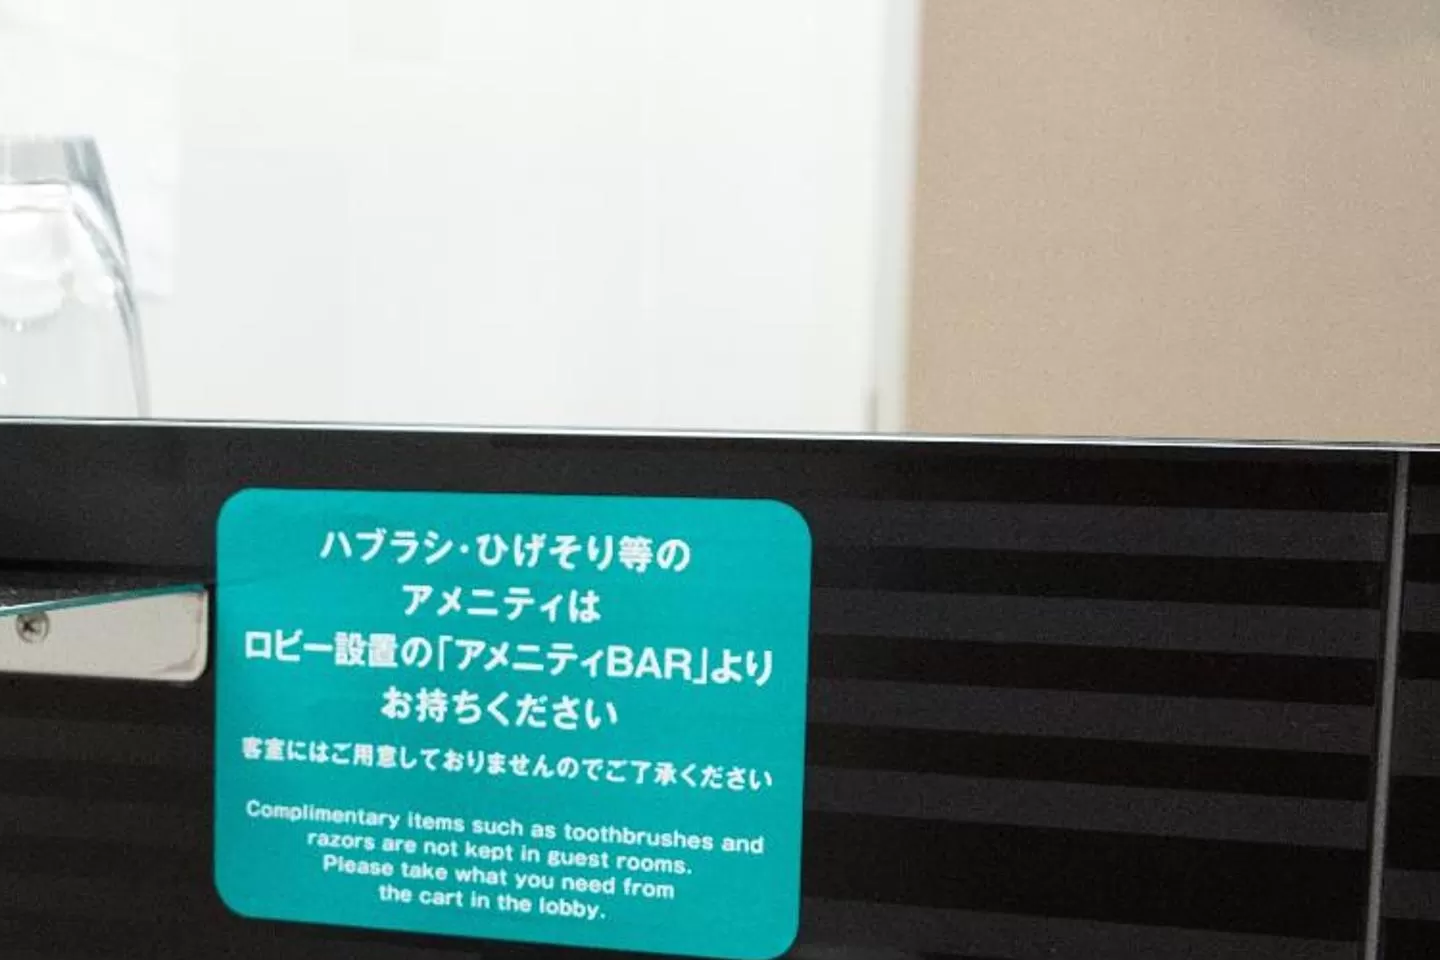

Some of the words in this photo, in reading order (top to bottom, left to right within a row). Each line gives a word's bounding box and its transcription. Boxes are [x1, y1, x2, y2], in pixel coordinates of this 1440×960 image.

[402, 585, 601, 622] アメニティは
[245, 630, 773, 686] ロビー設置の「アメニティBAR」より
[381, 686, 617, 731] お持ちください
[246, 801, 400, 830] Complimentary
[407, 812, 464, 832] items
[472, 815, 523, 836] such
[531, 821, 555, 837] as
[564, 823, 713, 849] toothbrushes
[722, 835, 764, 853] and
[308, 832, 373, 851] razors
[382, 837, 416, 853] are
[425, 837, 459, 855] not
[465, 839, 514, 861] kept
[521, 845, 540, 862] in
[548, 848, 609, 869] guest
[617, 855, 692, 874] rooms.
[323, 855, 393, 877] Please
[400, 862, 447, 880] take
[455, 865, 507, 886] what
[515, 870, 555, 893] you
[563, 874, 615, 894] need
[622, 879, 675, 898] from
[379, 886, 412, 904] the
[420, 889, 463, 907] cart
[471, 892, 490, 908] in
[497, 894, 531, 912] the
[539, 895, 605, 920] lobby.
